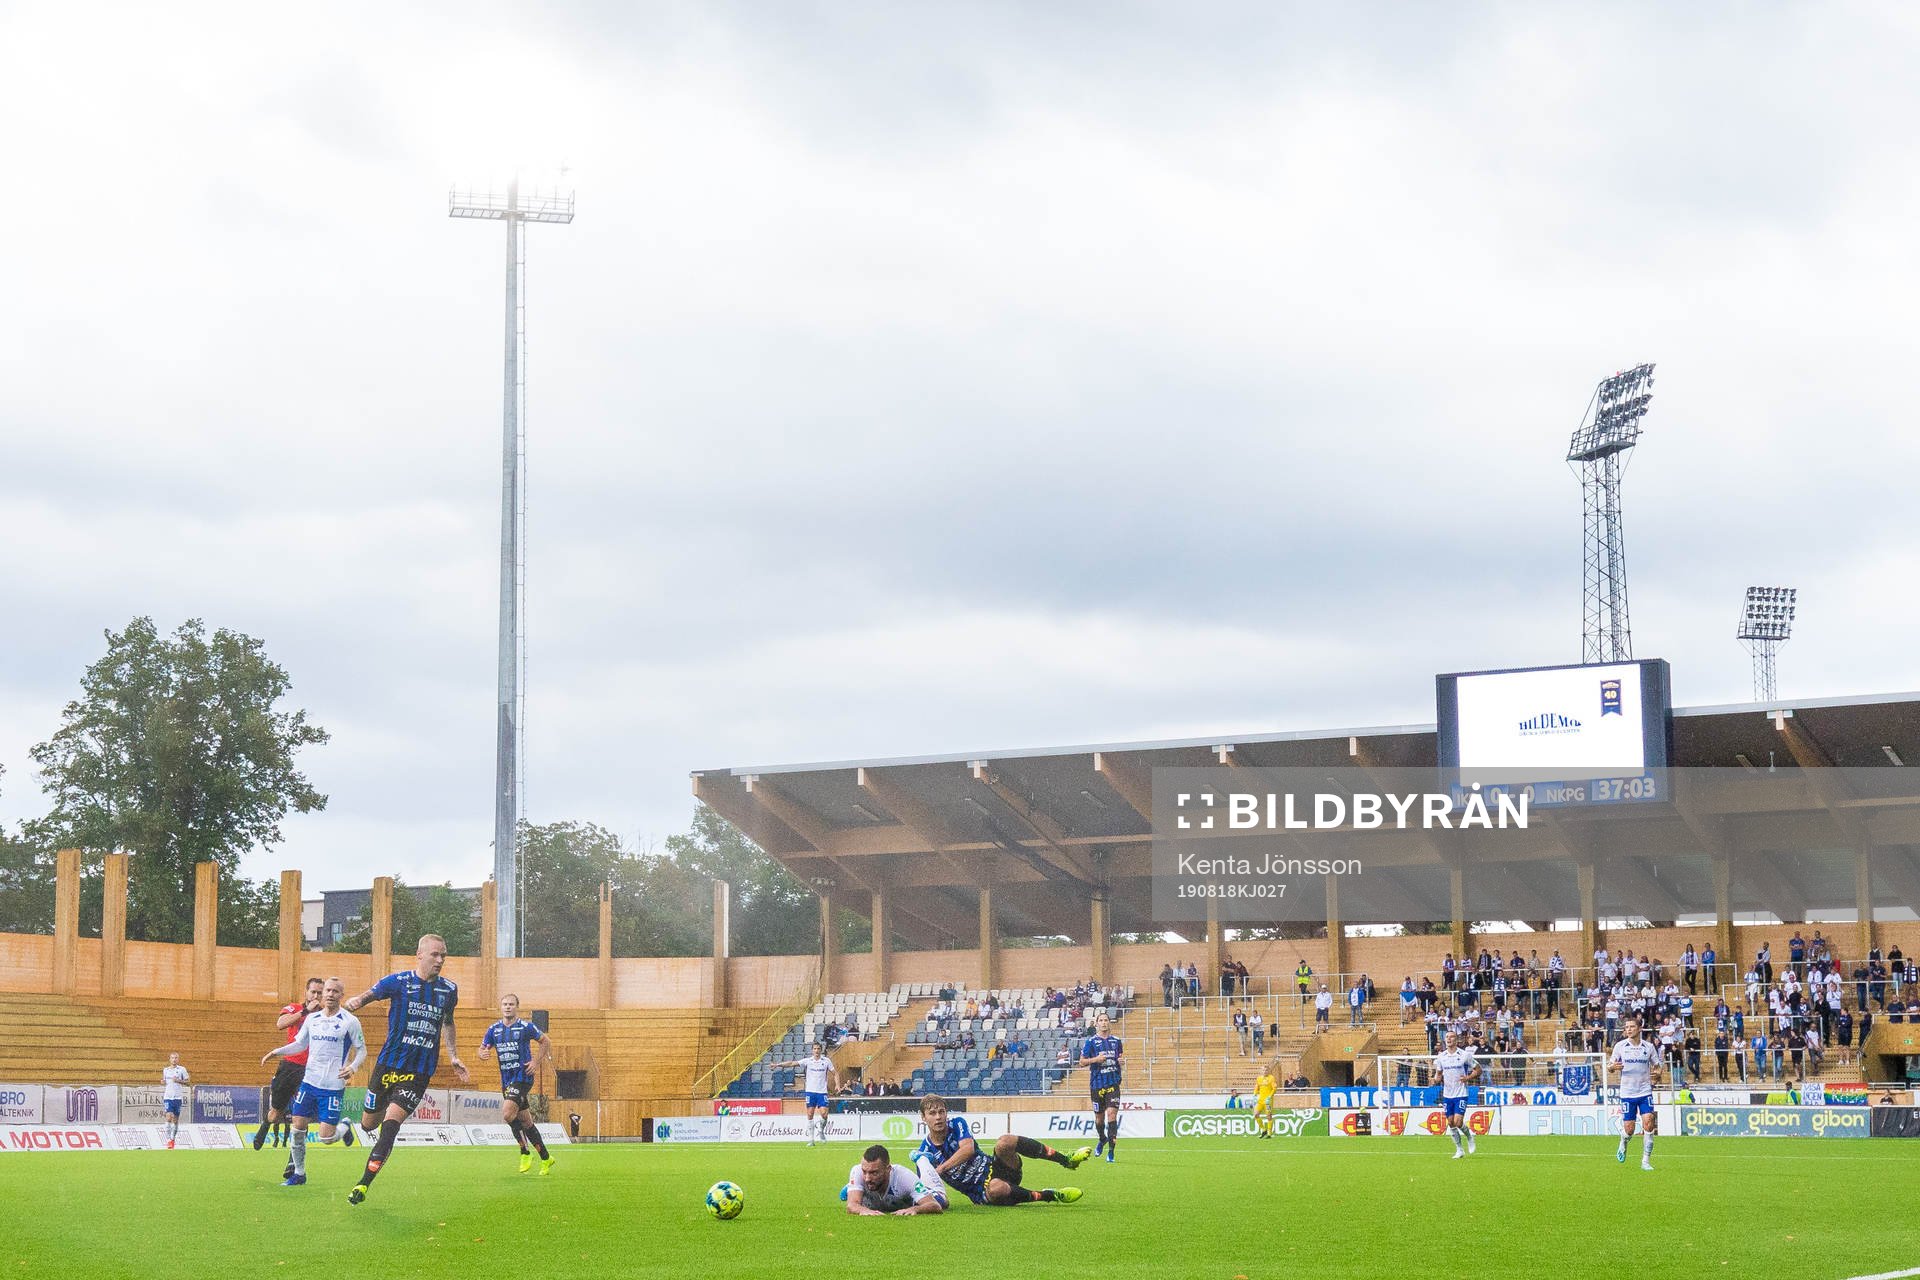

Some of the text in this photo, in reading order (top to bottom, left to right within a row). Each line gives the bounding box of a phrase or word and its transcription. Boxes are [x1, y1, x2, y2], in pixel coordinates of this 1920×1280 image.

[1547, 787, 1584, 803] NKPG
[1599, 777, 1656, 800] 37:03
[408, 1001, 426, 1010] BYGG
[407, 1009, 442, 1020] CONSTRUCT
[381, 1072, 415, 1088] gibon
[463, 1098, 500, 1110] DAIKIN
[750, 1121, 803, 1137] Andersson
[1686, 1108, 1737, 1136] gibon
[1748, 1109, 1800, 1136] gibon
[1811, 1110, 1865, 1136] gibon
[657, 1125, 670, 1138] GK
[9, 1131, 103, 1149] MOTOR
